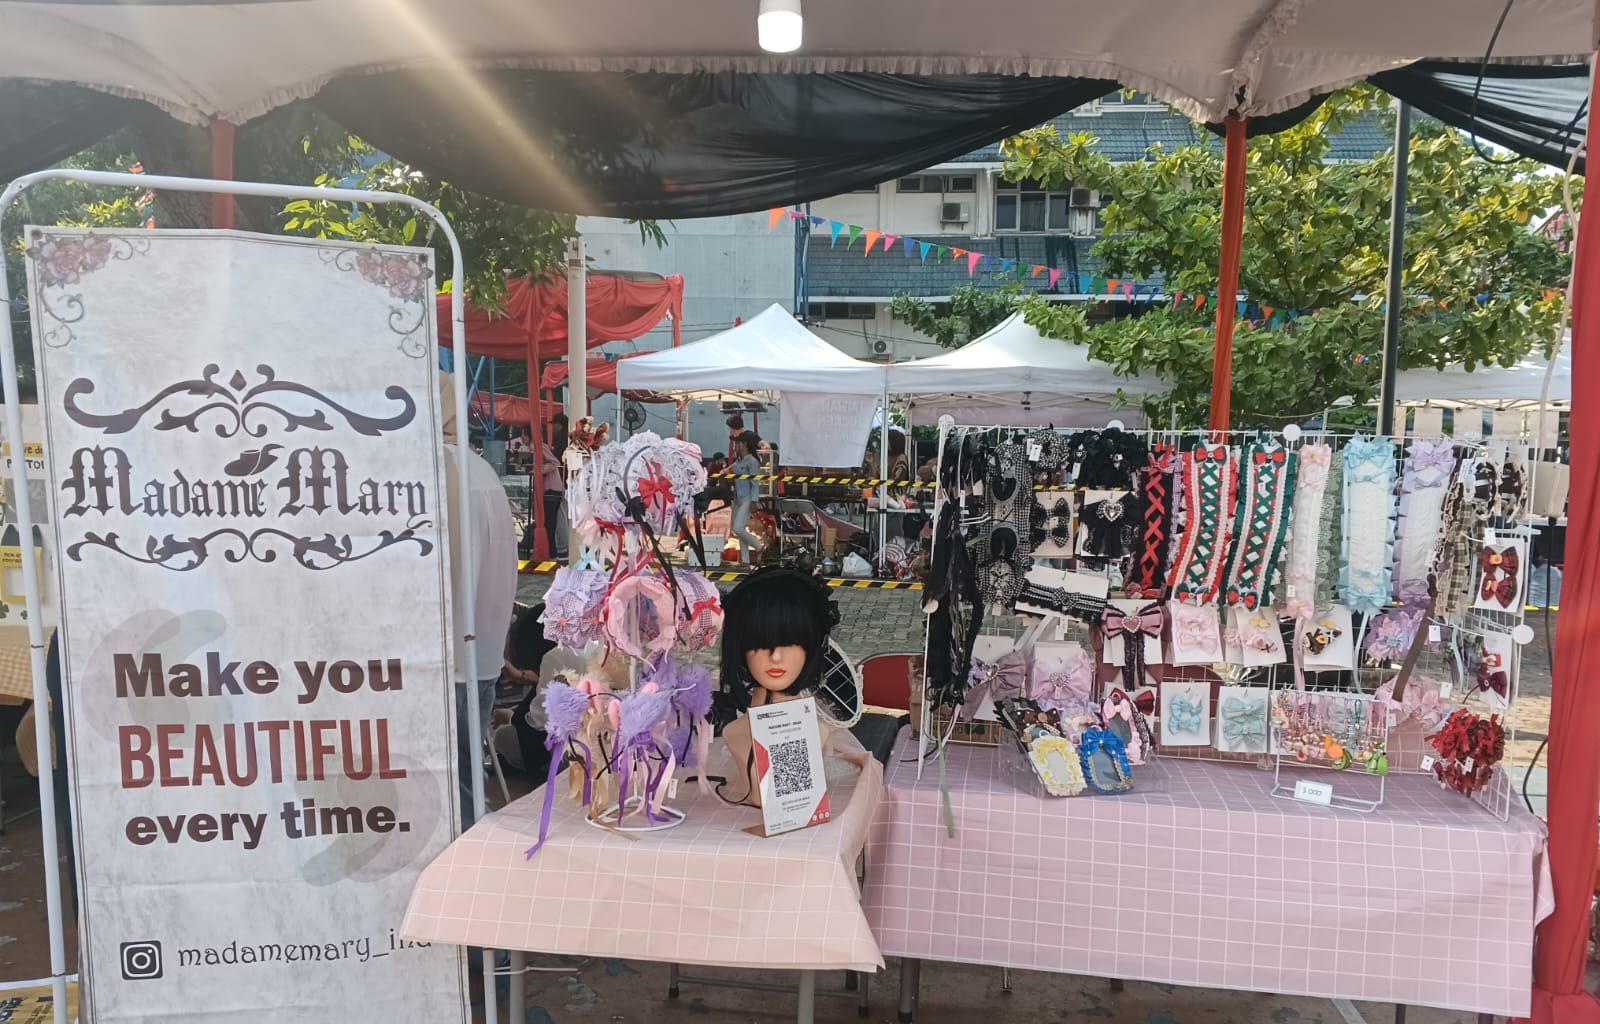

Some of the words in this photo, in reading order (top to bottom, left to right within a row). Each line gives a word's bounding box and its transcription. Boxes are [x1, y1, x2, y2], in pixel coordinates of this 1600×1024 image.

[61, 444, 268, 519] Madame
[277, 445, 433, 529] Mary
[113, 652, 279, 698] Make
[294, 658, 403, 704] you
[118, 718, 407, 789] BEAUTIFUL
[125, 812, 268, 850] every
[280, 798, 411, 839] time.
